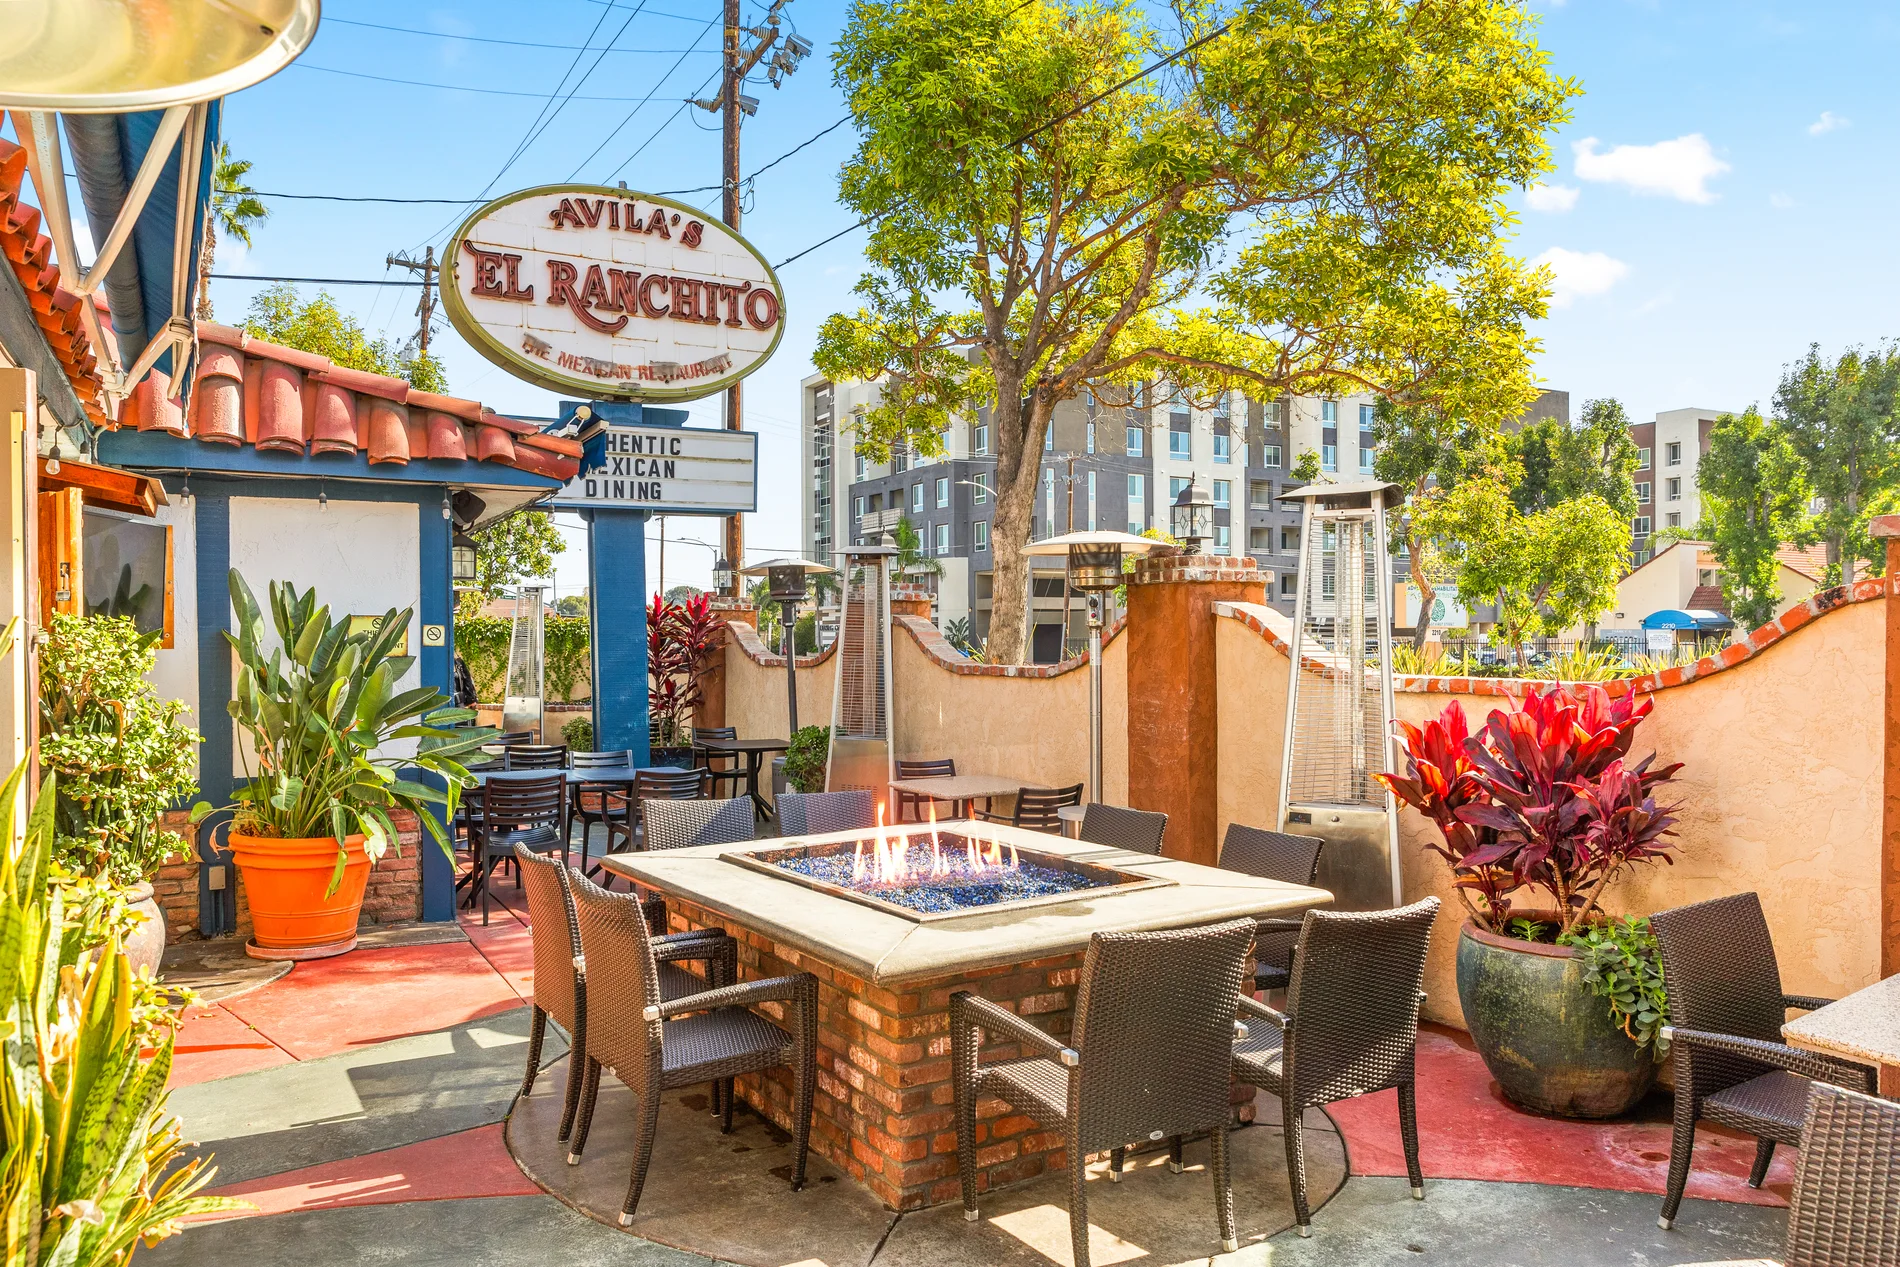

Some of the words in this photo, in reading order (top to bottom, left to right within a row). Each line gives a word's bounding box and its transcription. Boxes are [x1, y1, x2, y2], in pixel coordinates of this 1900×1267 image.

[549, 197, 705, 249] AVILA'S
[463, 239, 534, 302] EL
[546, 258, 780, 335] RANCHITO
[557, 351, 632, 380] MEXICAN
[588, 457, 675, 479] XICAN
[585, 478, 662, 500] DINING
